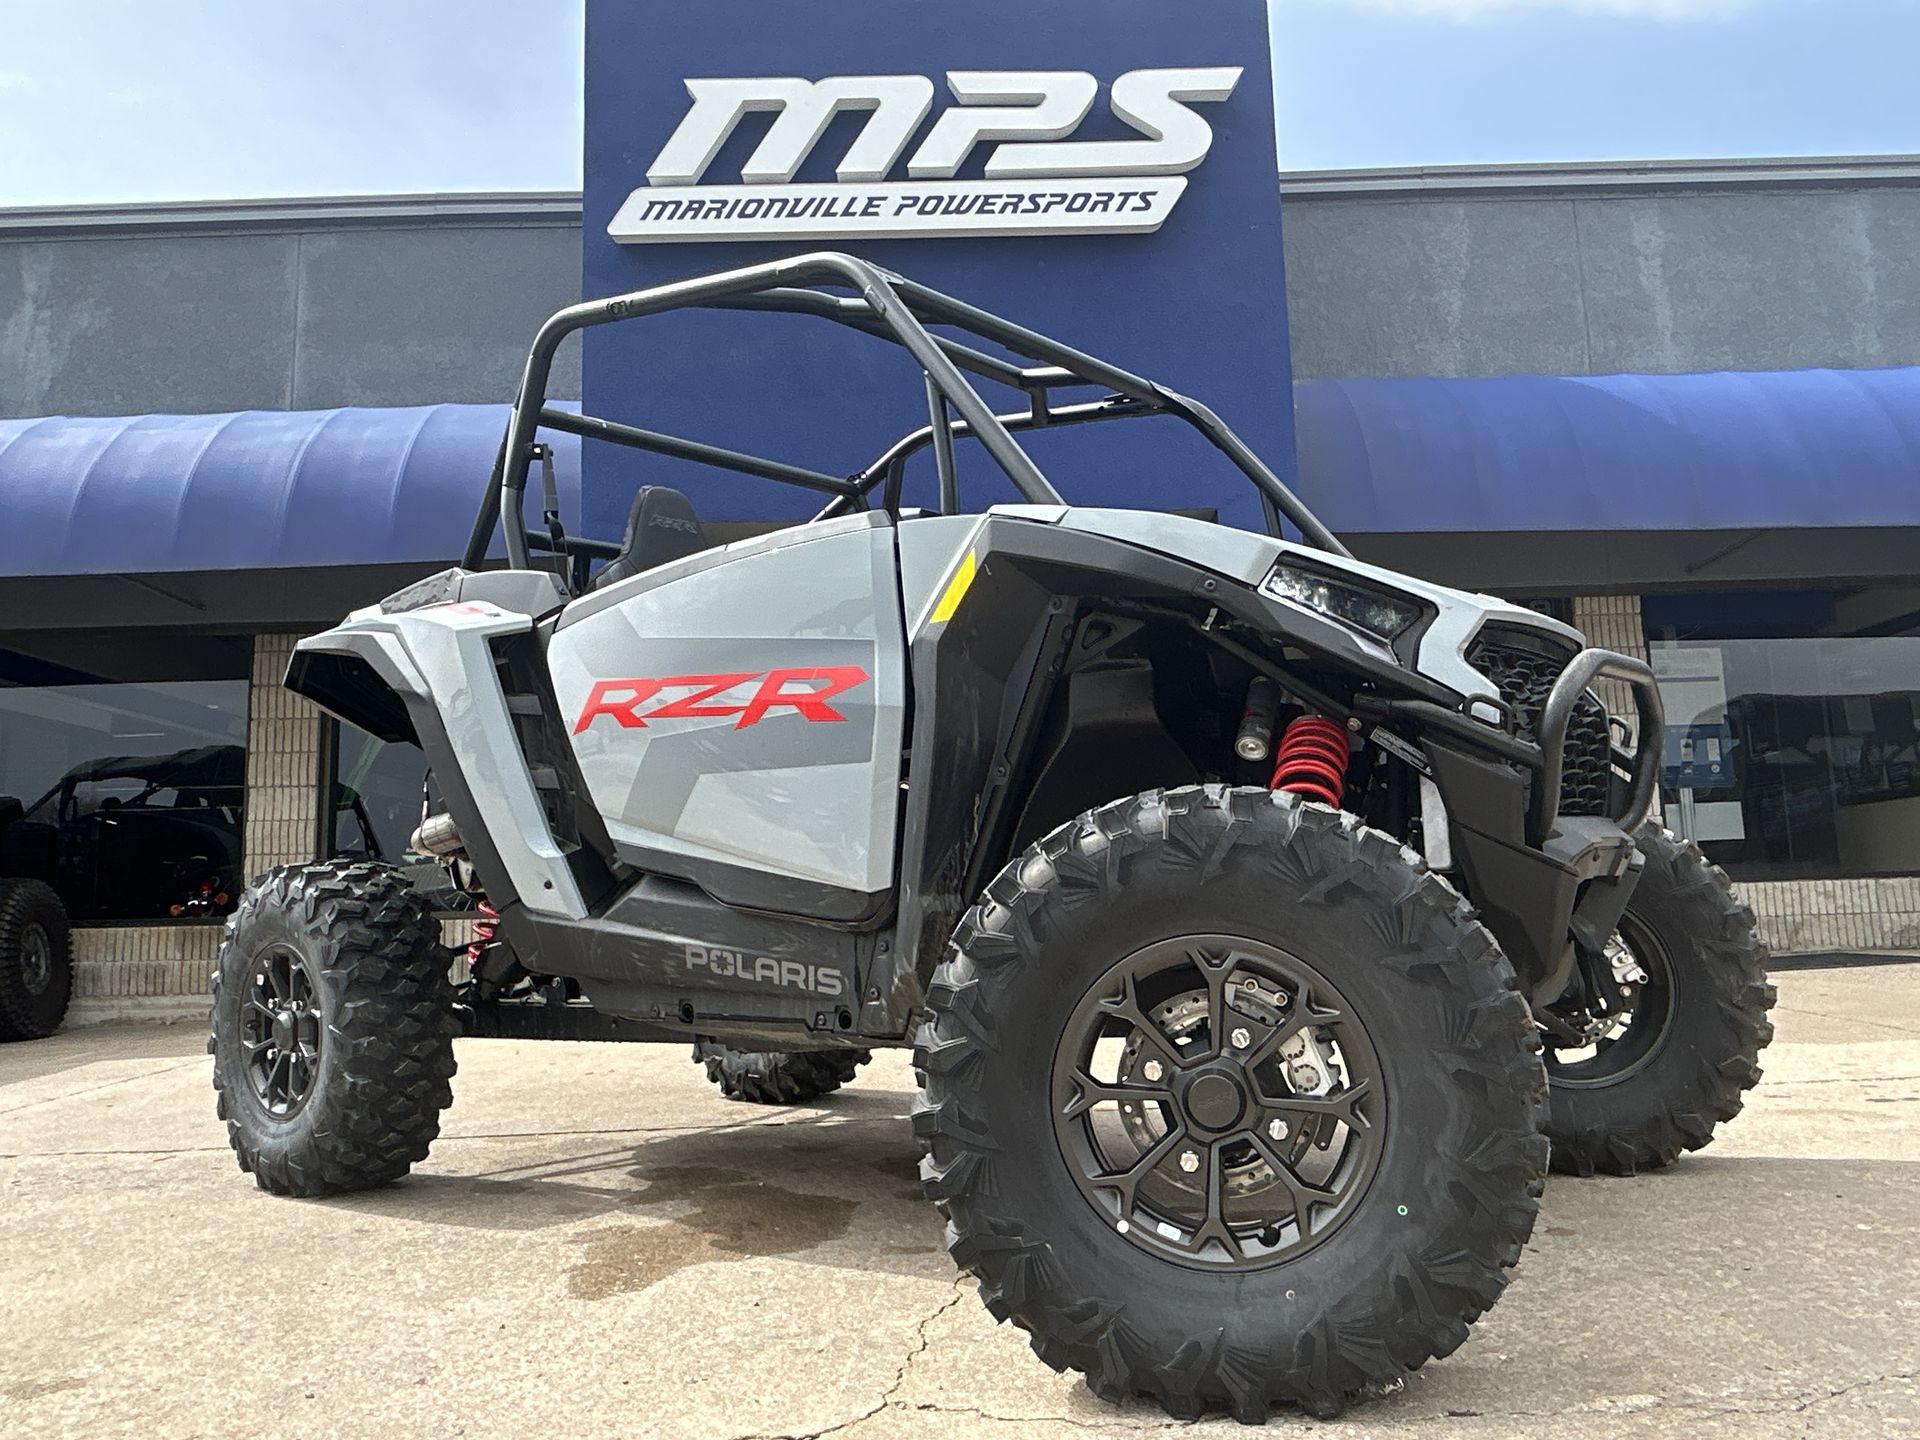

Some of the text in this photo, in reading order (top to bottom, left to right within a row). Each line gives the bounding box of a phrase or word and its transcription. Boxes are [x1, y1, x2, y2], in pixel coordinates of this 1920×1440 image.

[645, 66, 1244, 184] MPS
[640, 191, 1159, 222] MARIONVILLE POWERSPORTS
[572, 665, 871, 735] RZR
[685, 945, 843, 996] POLARIS
